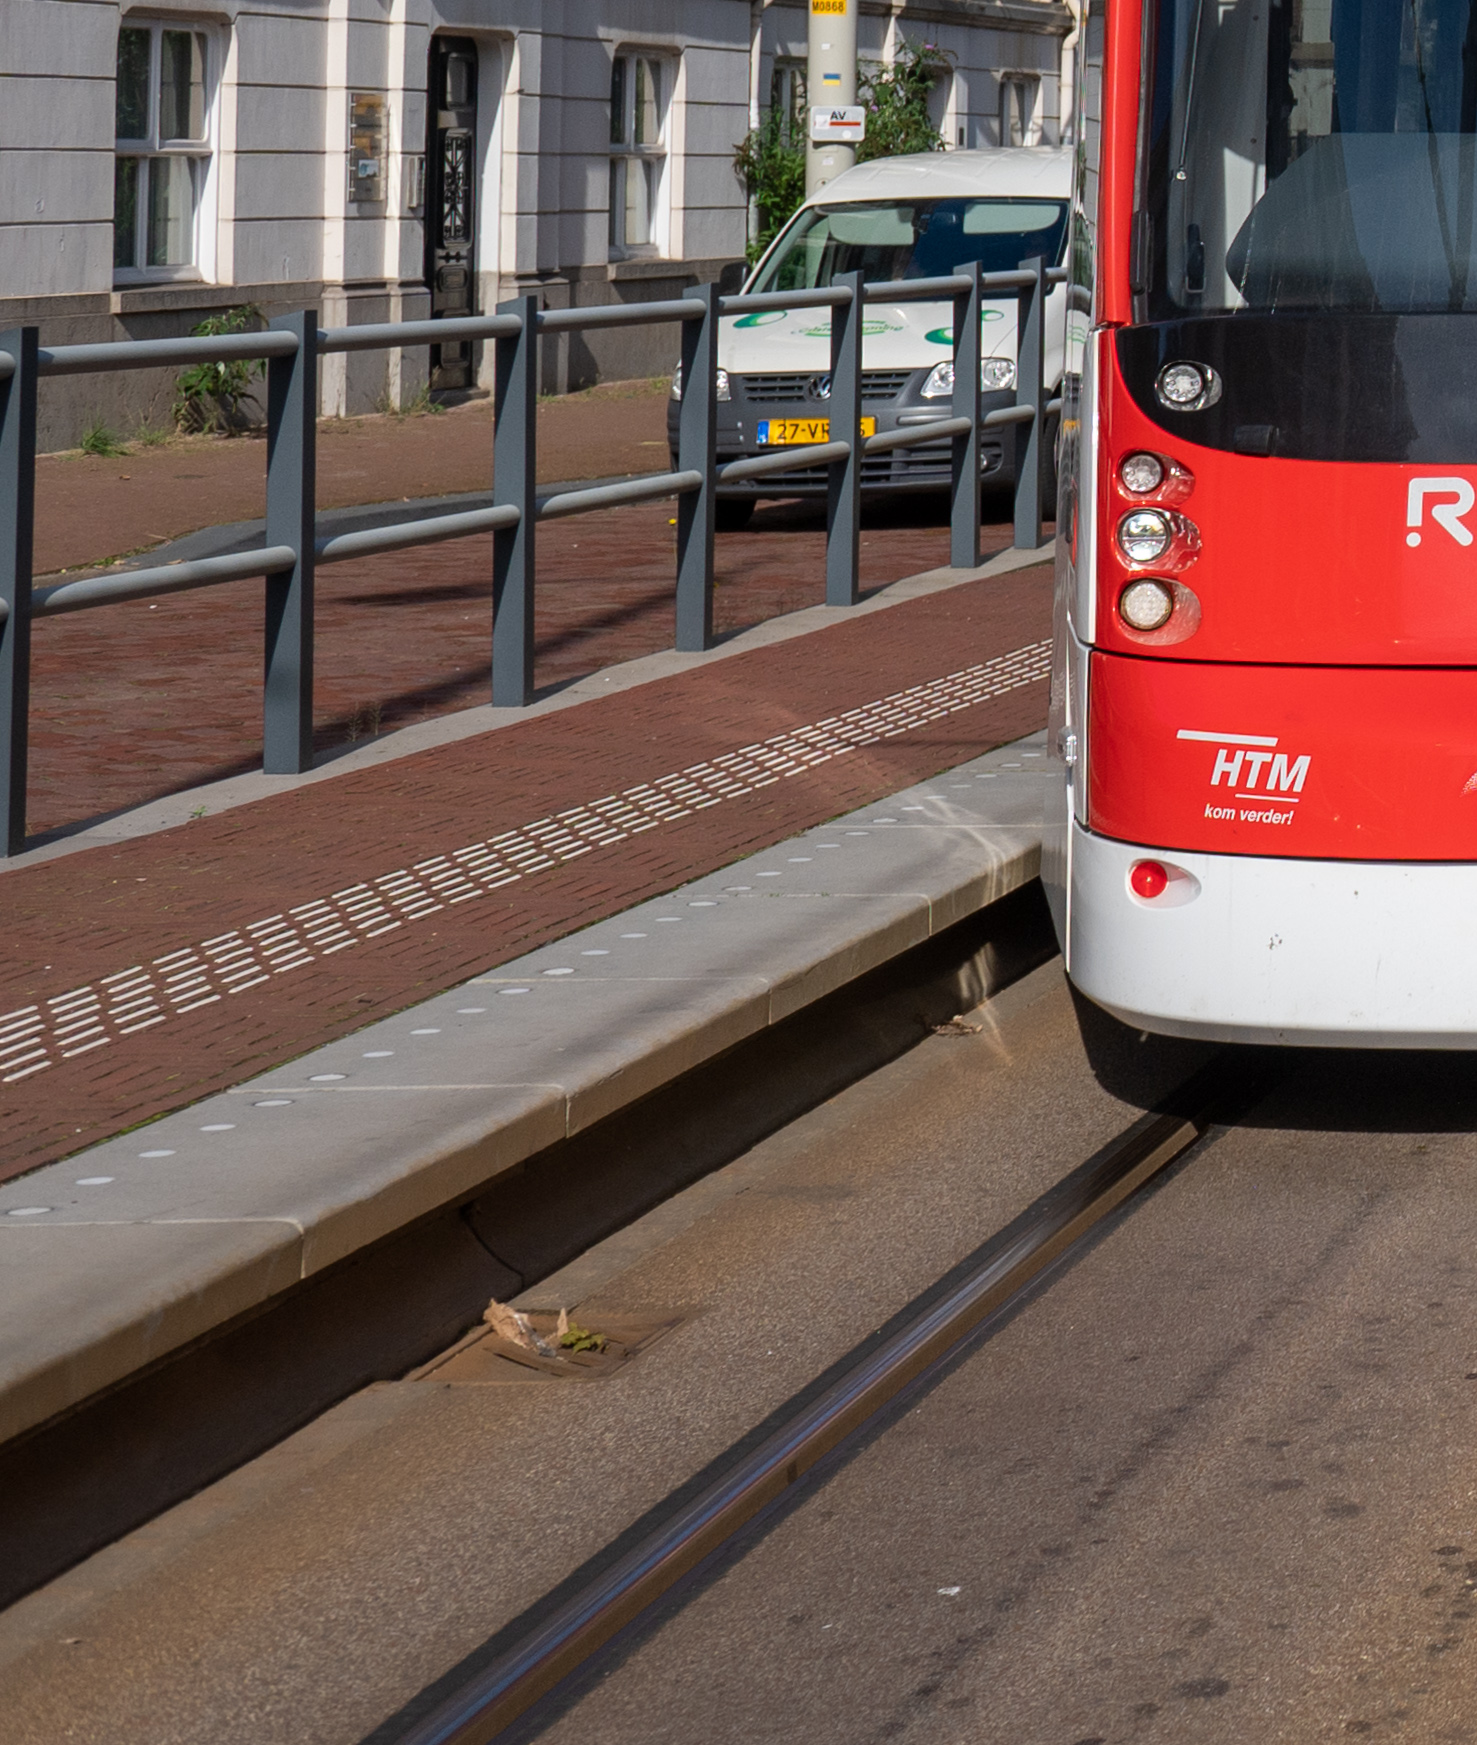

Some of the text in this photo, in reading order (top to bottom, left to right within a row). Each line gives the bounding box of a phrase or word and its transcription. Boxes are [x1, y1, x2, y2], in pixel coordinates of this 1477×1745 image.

[830, 111, 847, 121] AV
[1210, 748, 1311, 793] HTM
[1204, 802, 1294, 826] kom verder!
